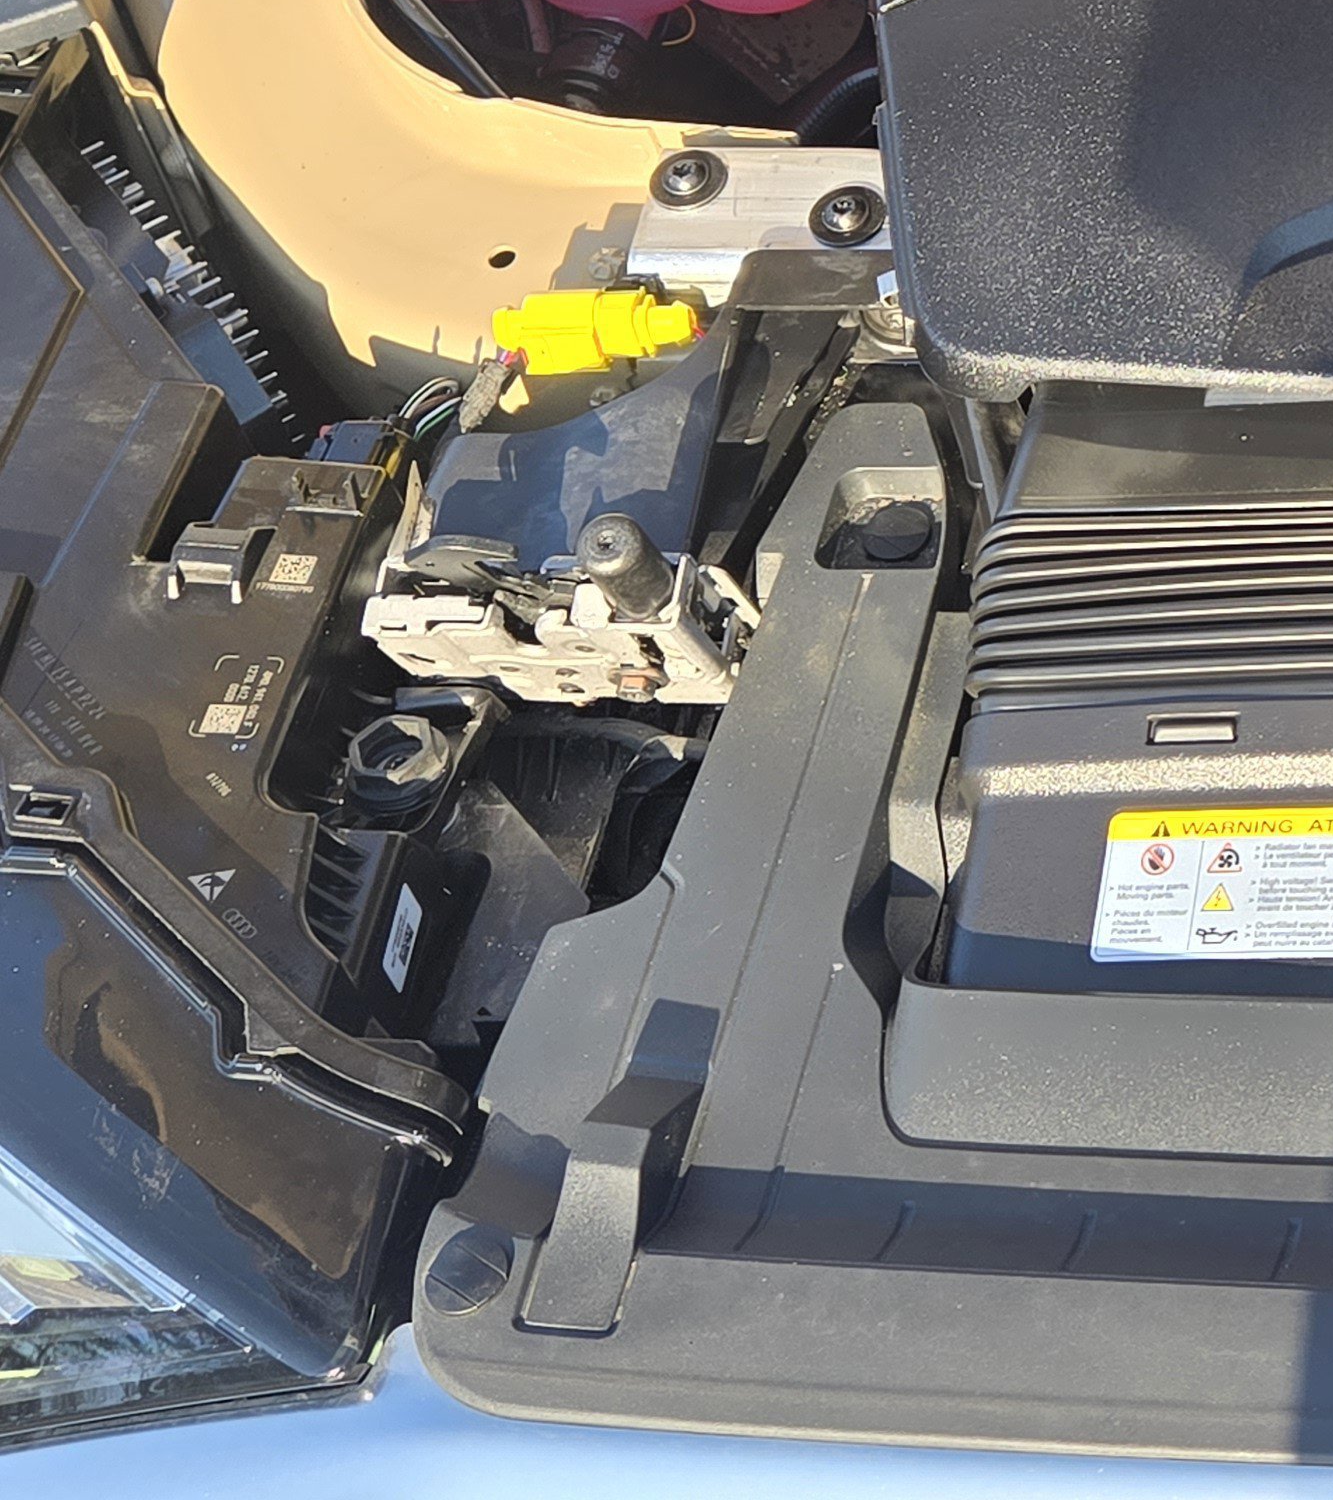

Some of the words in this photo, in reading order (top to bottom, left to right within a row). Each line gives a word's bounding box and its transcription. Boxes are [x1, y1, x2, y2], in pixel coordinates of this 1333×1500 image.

[1182, 819, 1293, 835] WARNING
[1260, 877, 1280, 886] High
[1135, 884, 1164, 892] engine
[1289, 887, 1327, 895] touching
[1117, 893, 1149, 901] Moving
[1255, 920, 1298, 929] Overfilled
[1300, 921, 1329, 930] engine
[1254, 930, 1267, 938] Un
[1269, 930, 1322, 939] remplissage
